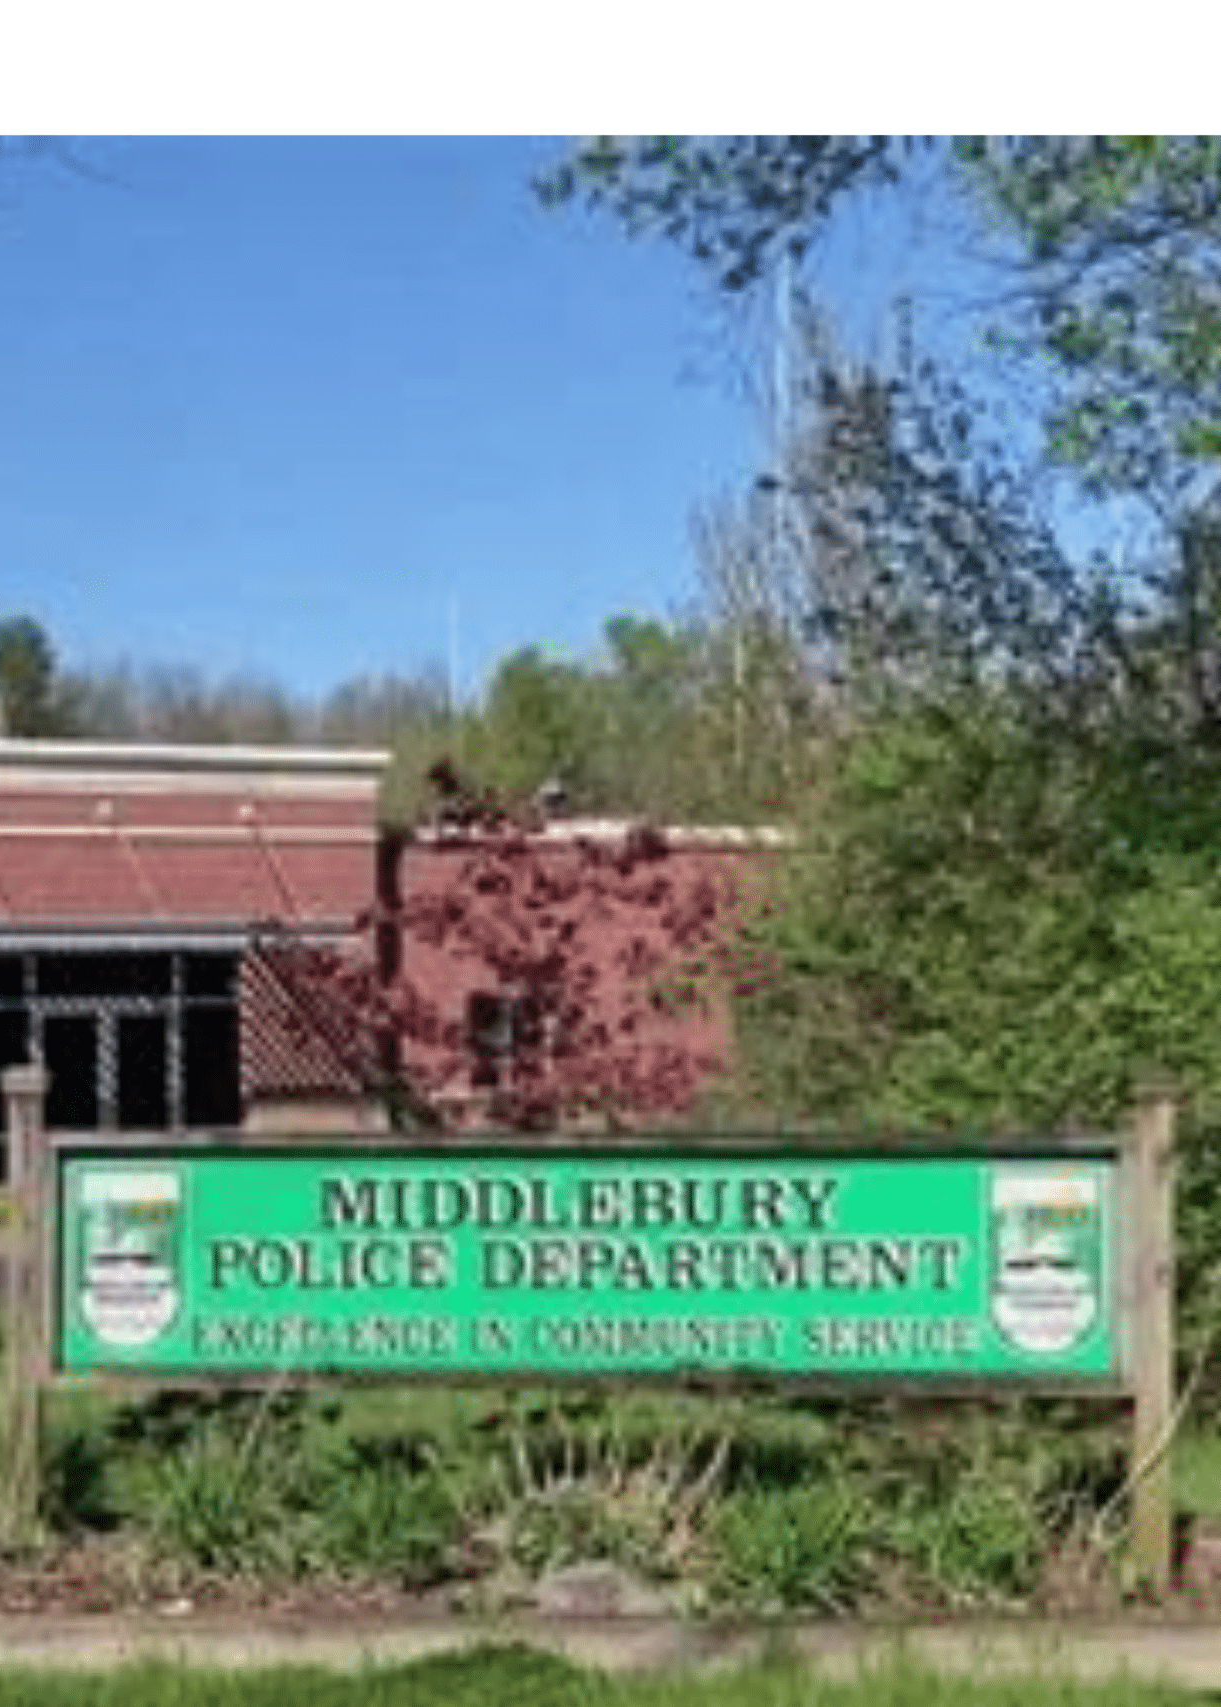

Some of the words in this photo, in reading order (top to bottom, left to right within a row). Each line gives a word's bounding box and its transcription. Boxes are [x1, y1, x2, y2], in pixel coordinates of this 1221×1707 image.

[319, 1177, 839, 1229] MIDDLEBURY
[209, 1240, 449, 1290] POLICE
[482, 1240, 963, 1292] DEPARTMENT
[192, 1314, 451, 1357] EXCELLENCE
[470, 1315, 513, 1356] IN
[530, 1315, 782, 1359] COMMUNITY
[801, 1317, 979, 1360] SERVICE
